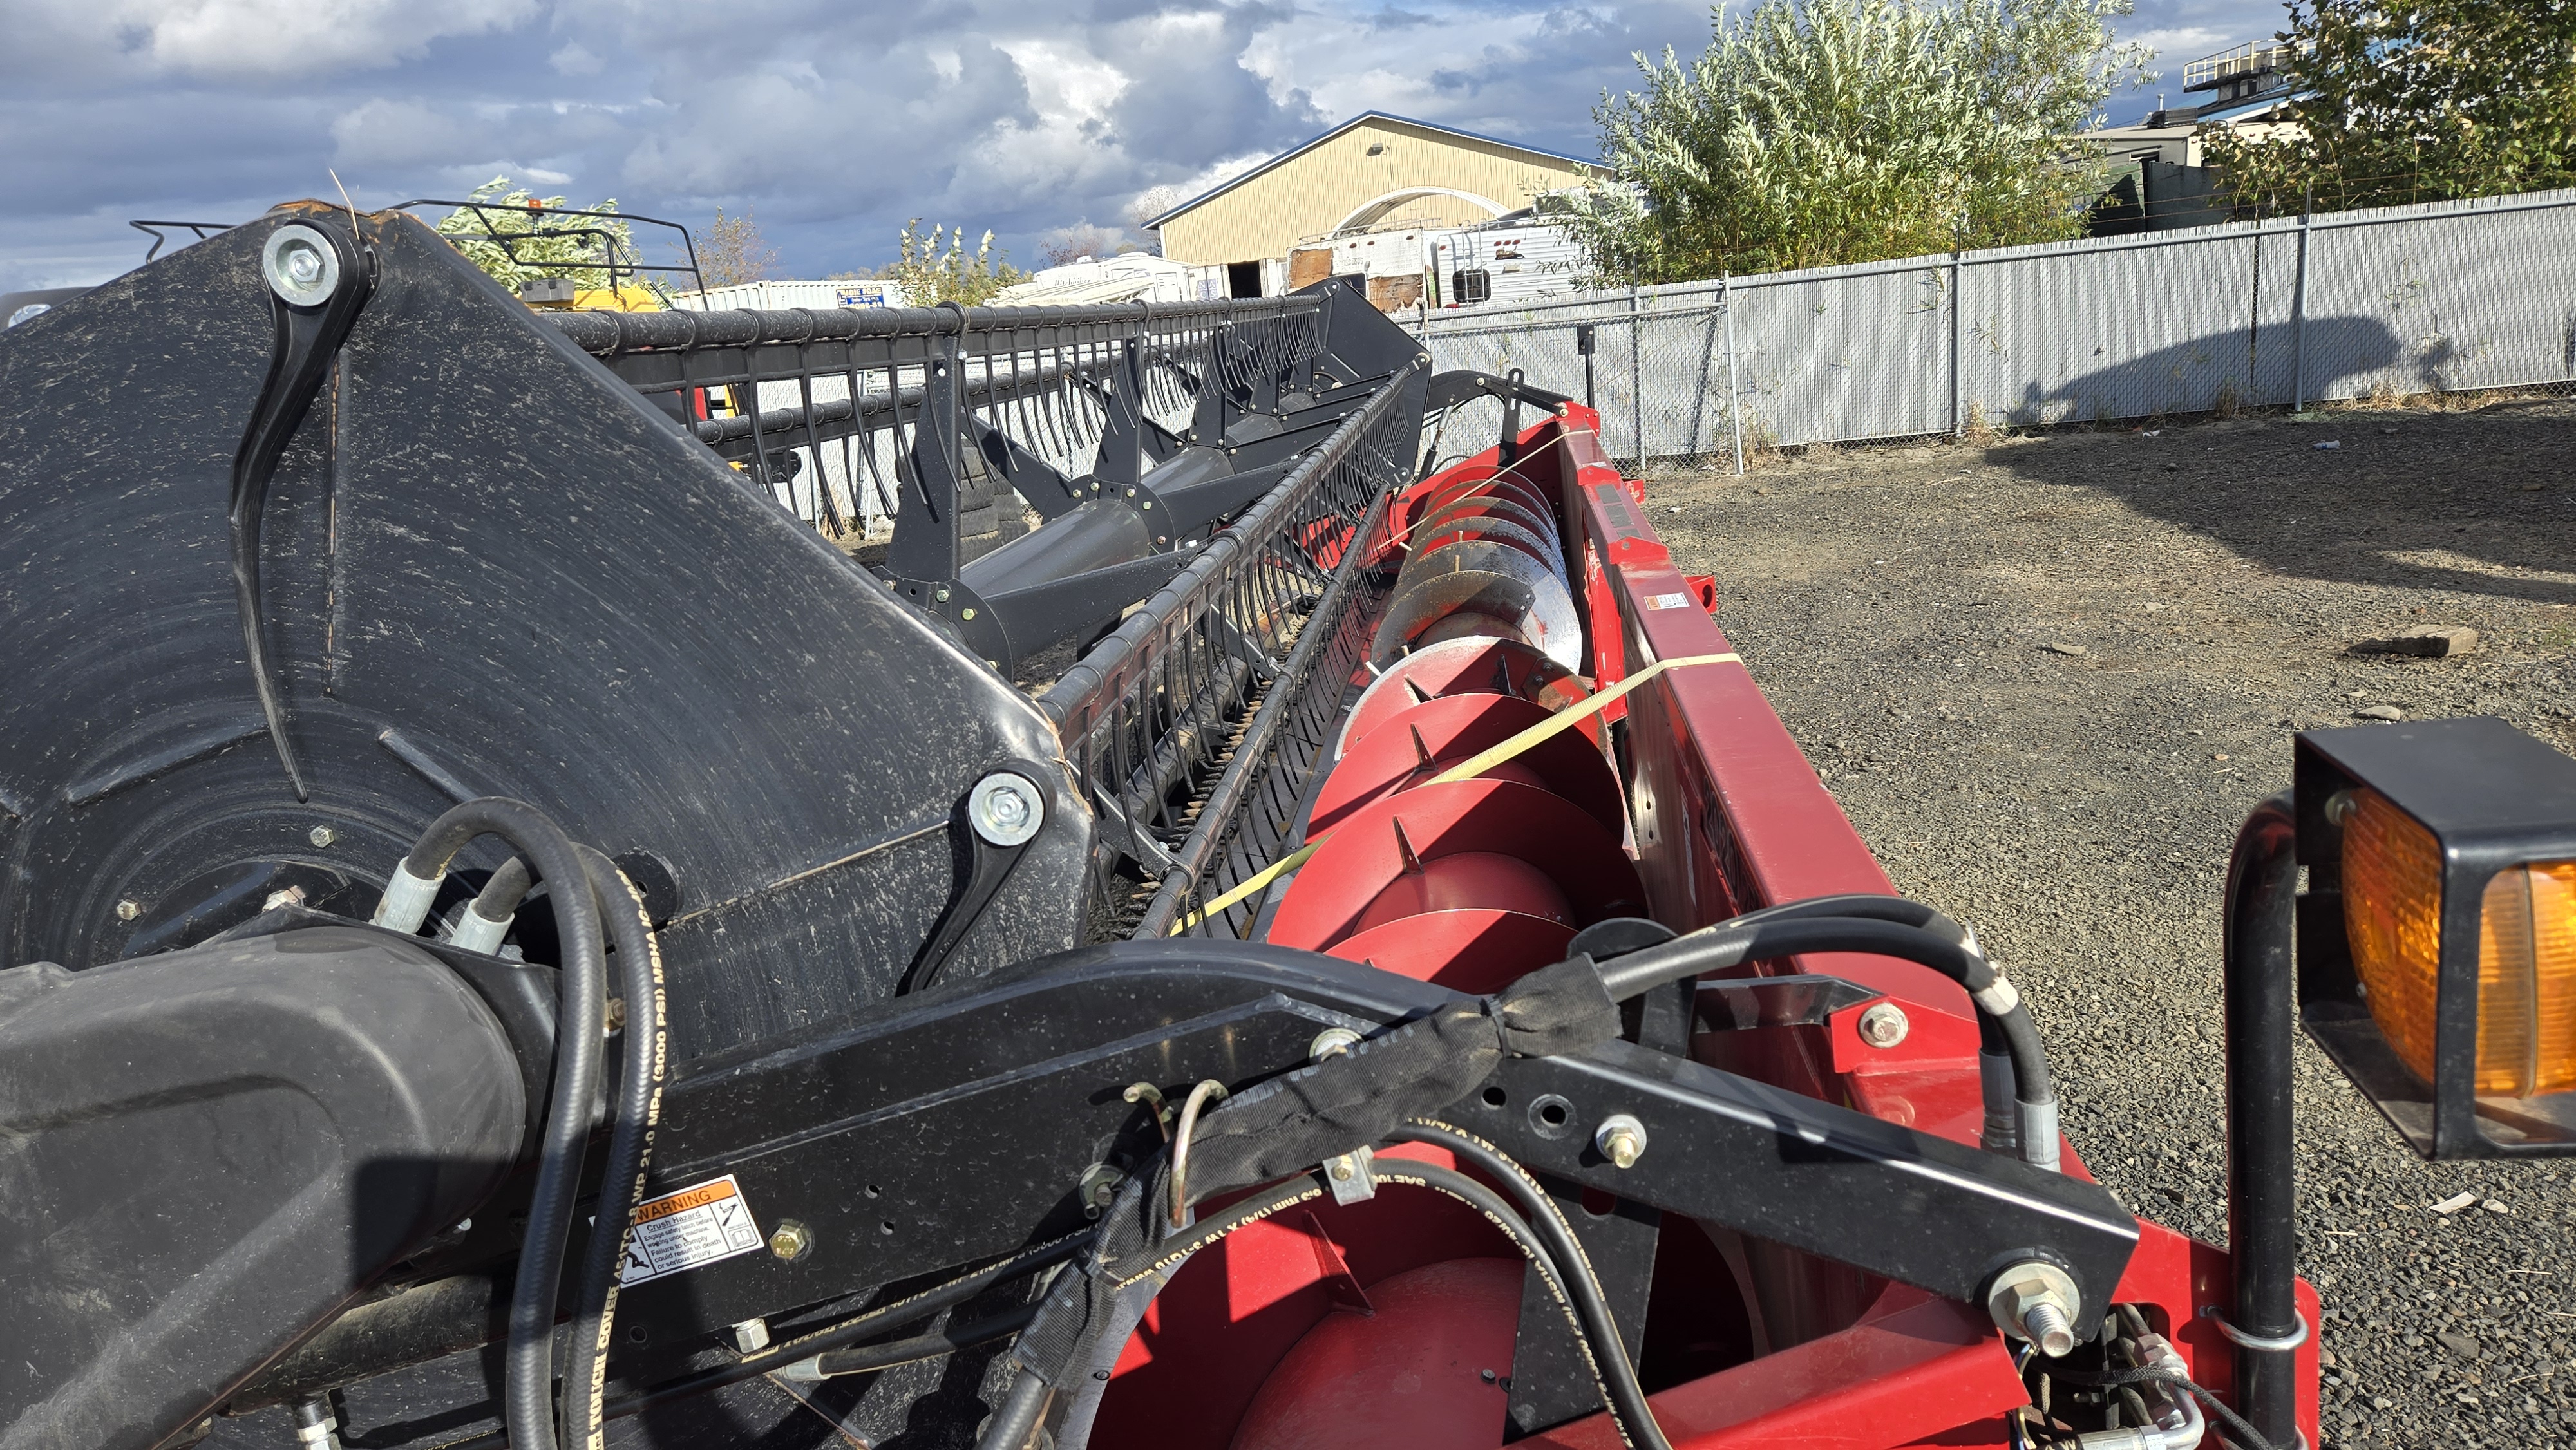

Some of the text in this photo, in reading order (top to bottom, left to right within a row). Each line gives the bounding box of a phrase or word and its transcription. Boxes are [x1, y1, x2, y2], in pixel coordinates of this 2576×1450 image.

[646, 932, 664, 984] MSHA
[654, 989, 666, 1026] PSI)
[653, 1031, 666, 1082] (3000
[647, 1087, 663, 1126] MPa
[641, 1131, 655, 1167] 21.0
[632, 1173, 645, 1202] WP
[638, 1190, 711, 1221] WARNING
[1272, 1196, 1300, 1211] mm
[645, 1232, 665, 1242] Engage
[665, 1226, 681, 1236] safety
[696, 1217, 713, 1226] before
[647, 1210, 701, 1232] Crush Hazard
[647, 1239, 668, 1249] working
[668, 1234, 685, 1243] under
[651, 1246, 674, 1256] Failure
[683, 1236, 708, 1247] comply
[654, 1253, 673, 1263] could
[674, 1248, 693, 1257] result
[703, 1239, 721, 1249] death
[665, 1256, 690, 1266] serious
[692, 1250, 713, 1260] injury.
[596, 1285, 620, 1351] COVER
